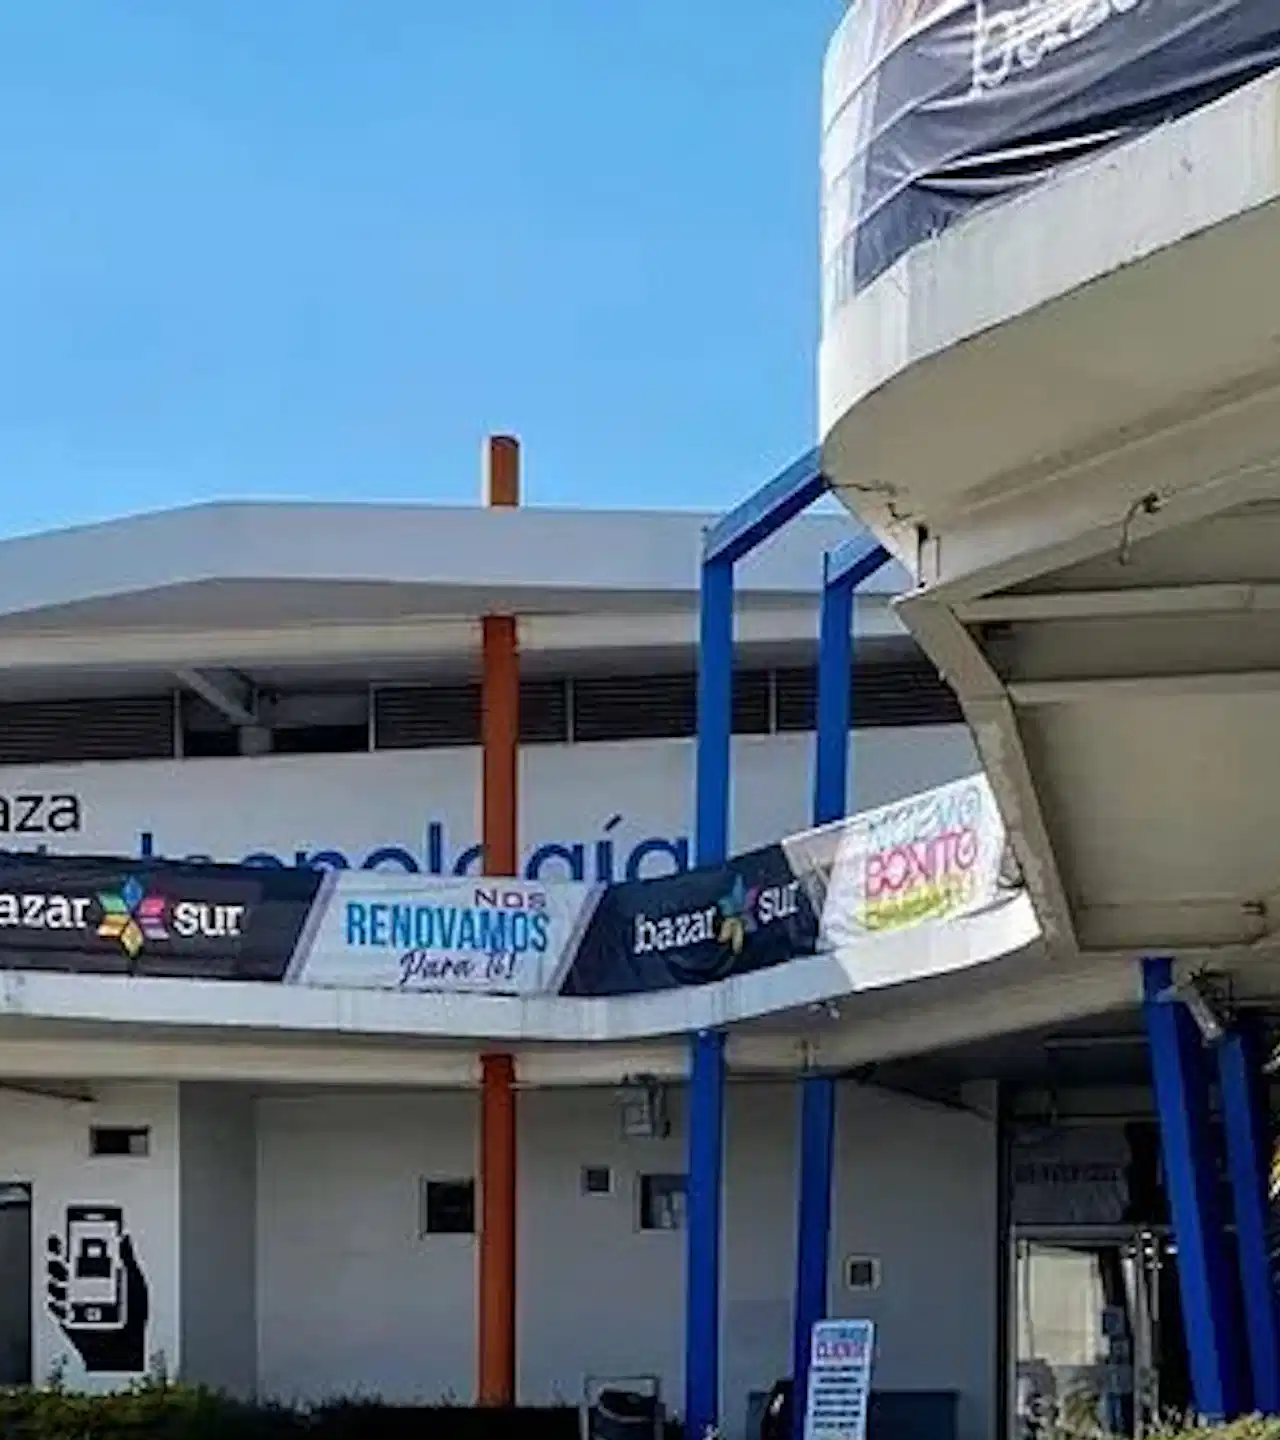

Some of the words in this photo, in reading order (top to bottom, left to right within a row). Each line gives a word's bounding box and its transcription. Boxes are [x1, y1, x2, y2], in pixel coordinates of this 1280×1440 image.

[866, 828, 977, 895] BONITO
[173, 898, 245, 936] sur
[347, 902, 549, 952] RENOVAMOS
[634, 905, 719, 955] bazar
[757, 880, 801, 925] sur
[399, 949, 476, 985] Para
